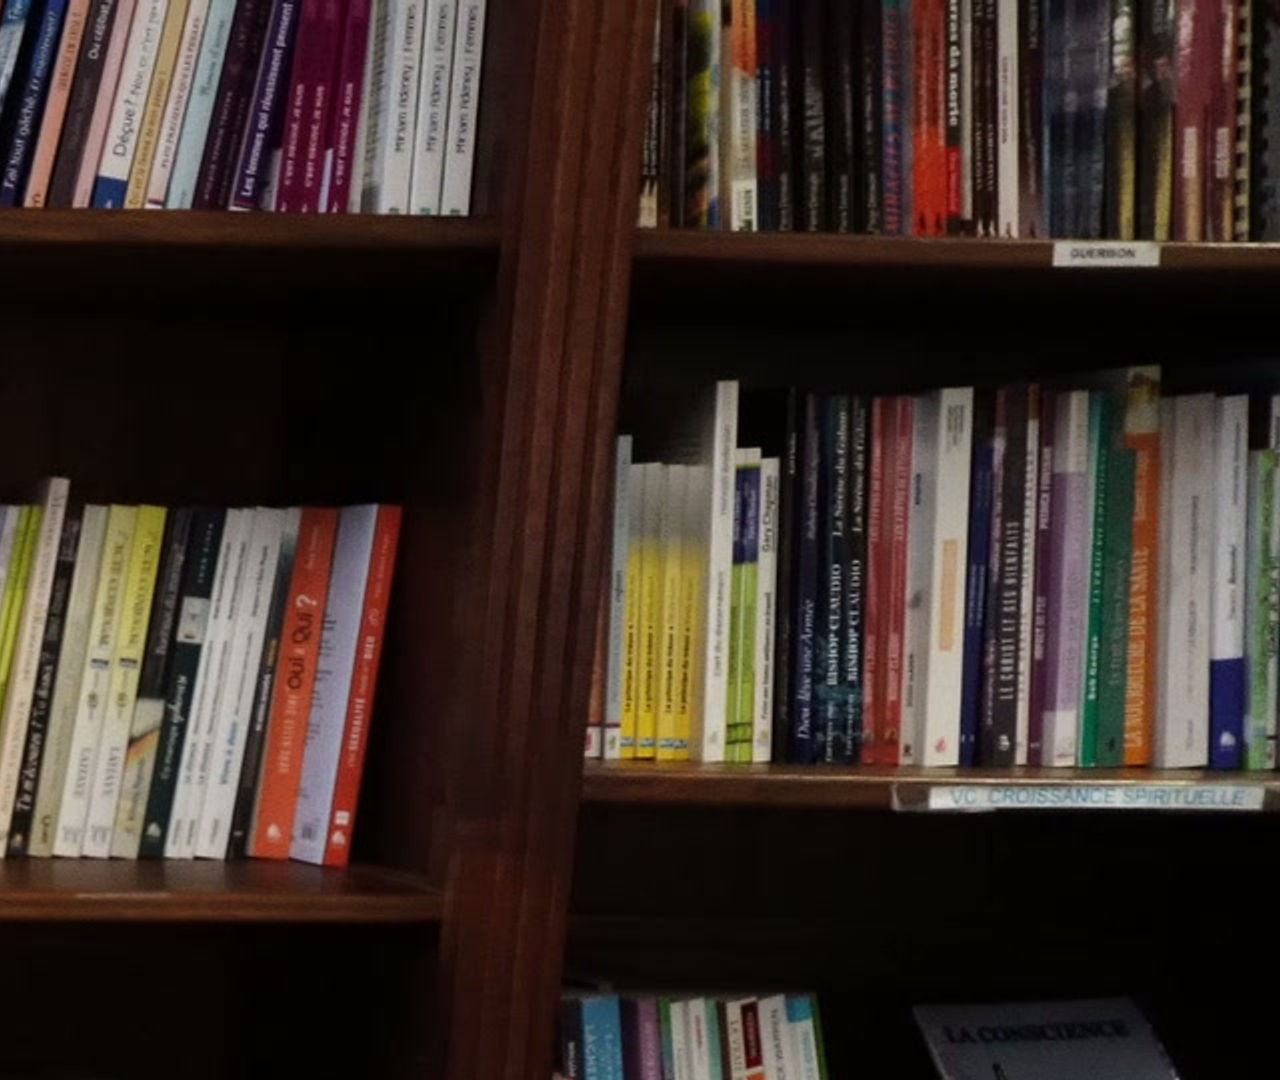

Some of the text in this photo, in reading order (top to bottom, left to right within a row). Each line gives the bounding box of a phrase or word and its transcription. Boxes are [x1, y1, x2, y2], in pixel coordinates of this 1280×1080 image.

[1069, 247, 1137, 259] GUERISON
[987, 786, 1246, 807] CROISSANCE SPIRITUELLE
